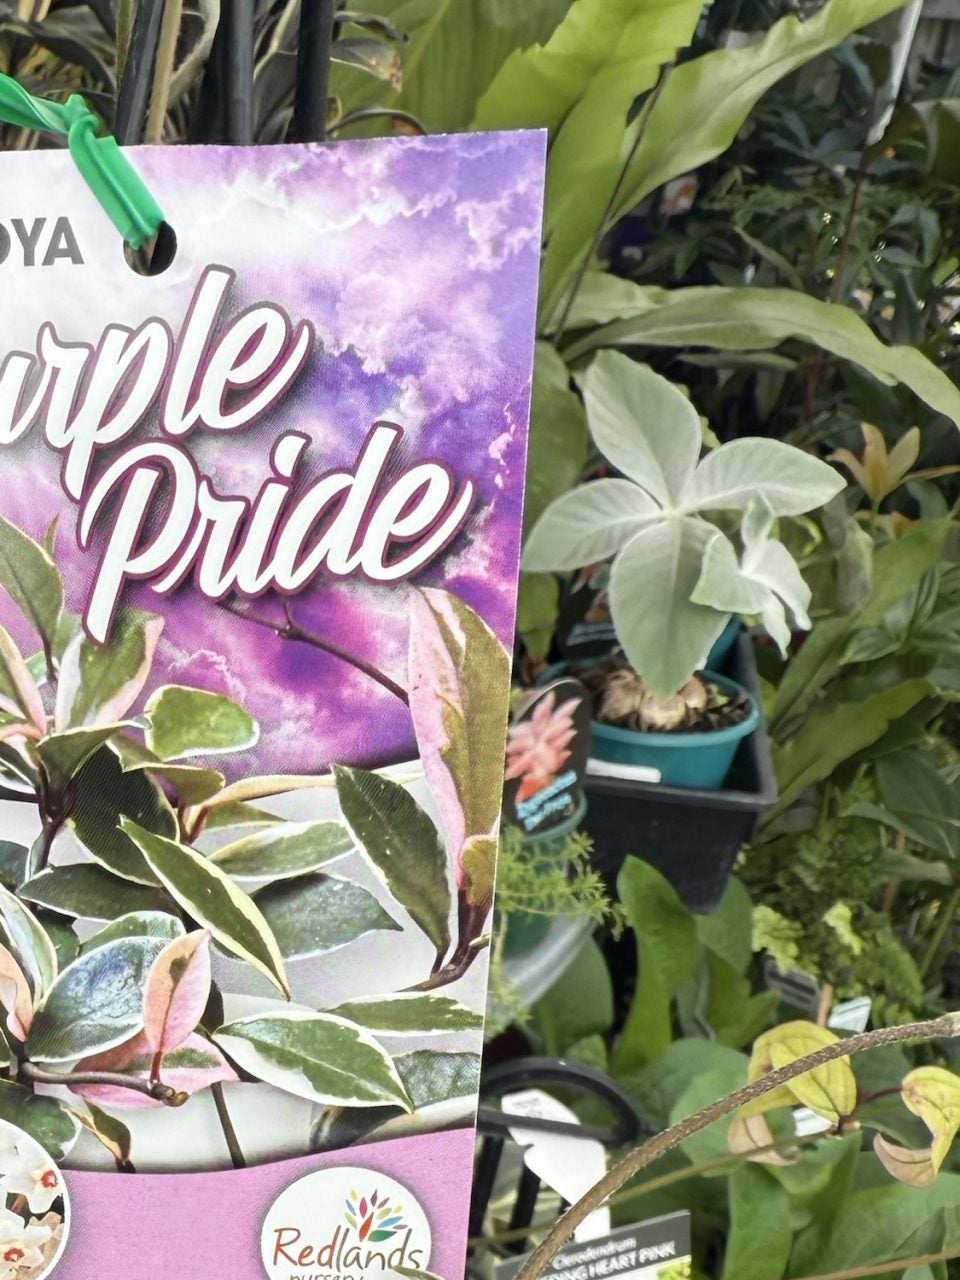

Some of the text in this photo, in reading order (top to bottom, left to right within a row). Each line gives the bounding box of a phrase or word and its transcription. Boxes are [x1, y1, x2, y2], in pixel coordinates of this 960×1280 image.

[77, 422, 474, 647] Pride
[272, 1224, 424, 1272] Redlands
[589, 1250, 638, 1278] HEART
[638, 1240, 677, 1264] PINK
